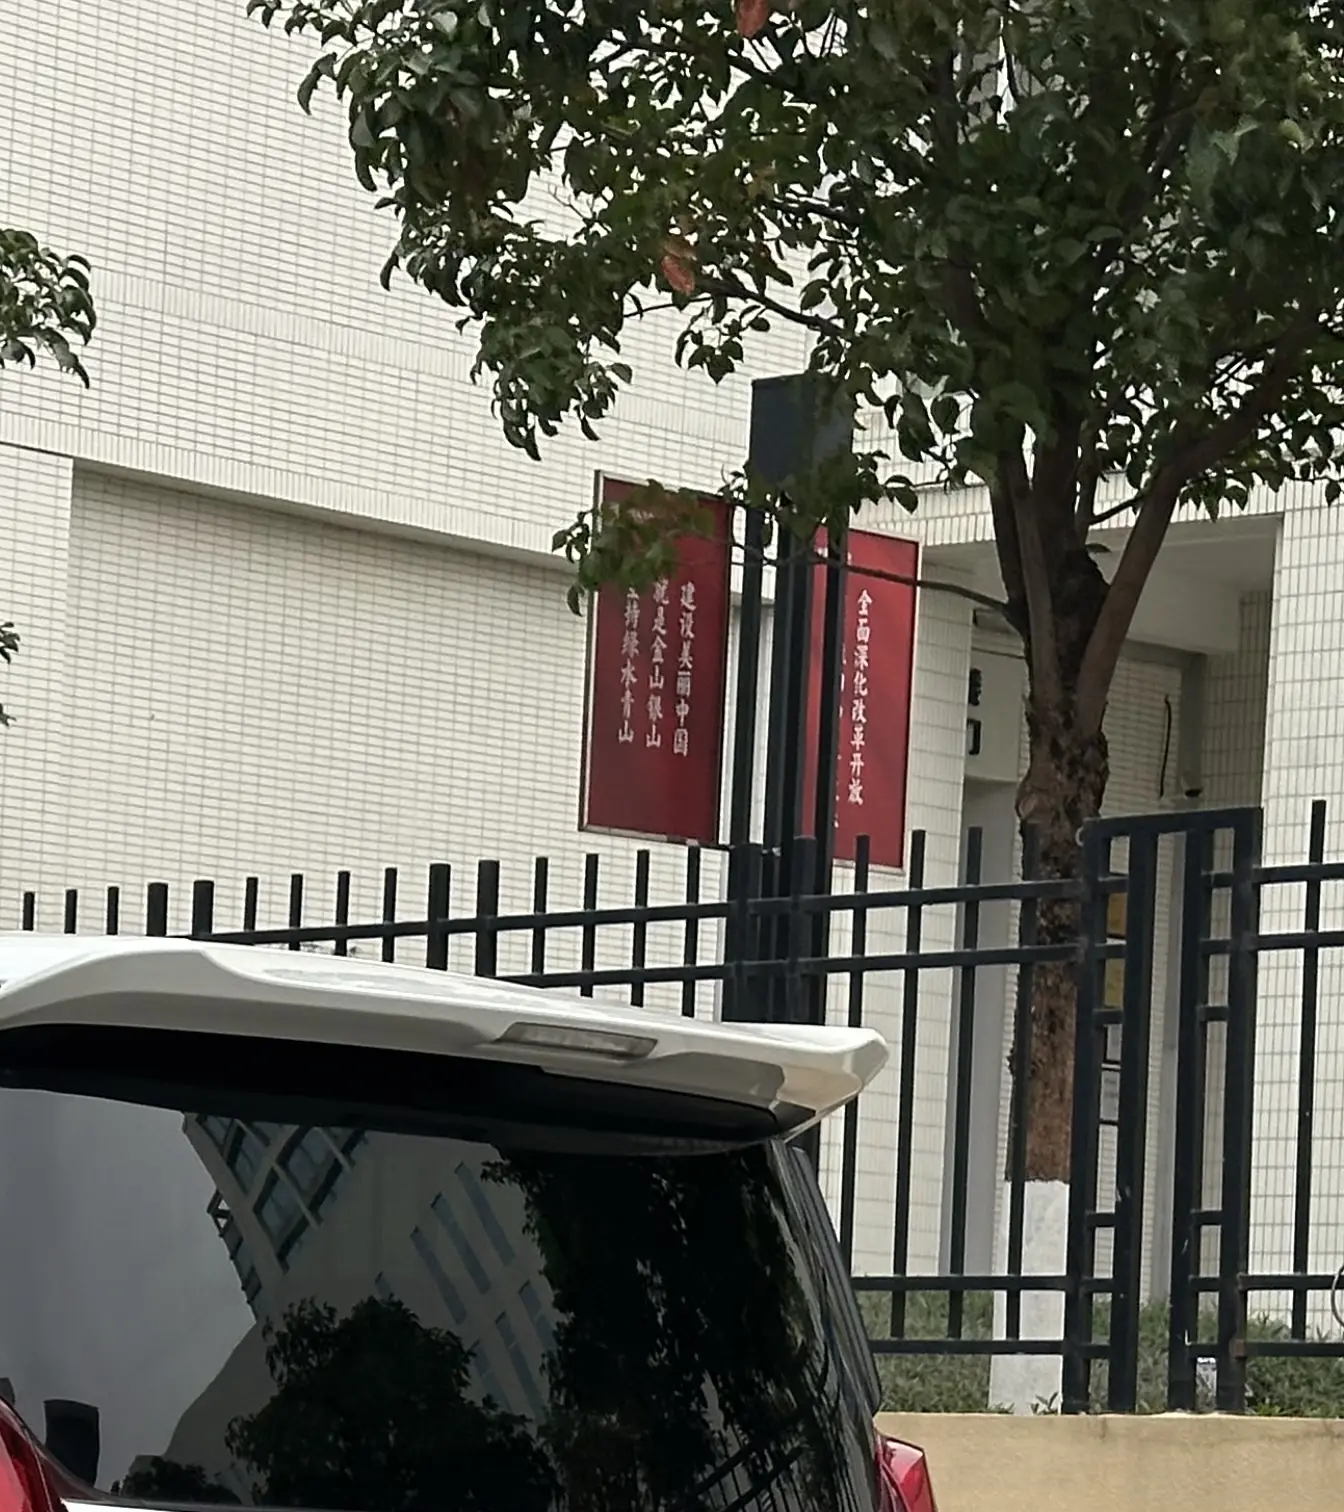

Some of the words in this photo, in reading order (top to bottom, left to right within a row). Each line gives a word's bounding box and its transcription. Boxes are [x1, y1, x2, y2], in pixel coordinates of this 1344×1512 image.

[646, 578, 670, 748] 就是金山银山
[673, 581, 697, 756] 建设美丽中国
[848, 589, 872, 806] 全面深化改革开放
